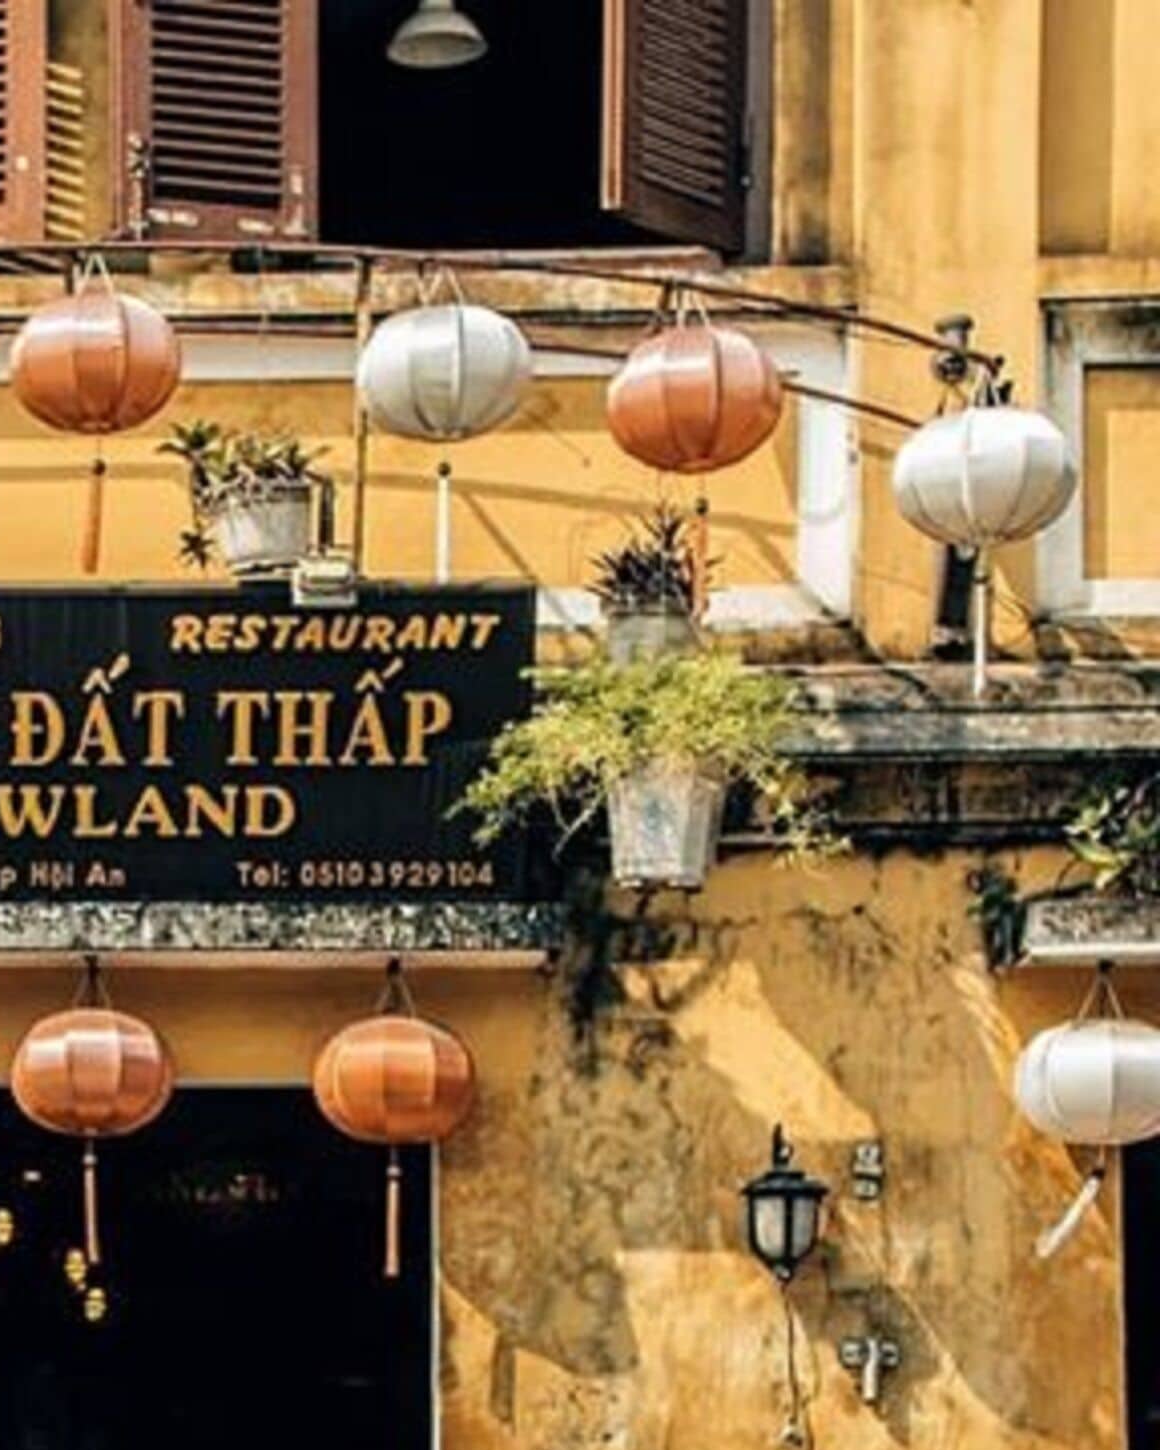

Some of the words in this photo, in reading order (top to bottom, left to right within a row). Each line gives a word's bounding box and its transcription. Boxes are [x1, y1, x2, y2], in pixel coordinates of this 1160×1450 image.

[170, 613, 501, 653] RESTAURANT
[10, 652, 185, 766] ĐẤT
[216, 656, 452, 766] THẤP
[86, 862, 126, 886] An
[237, 861, 287, 886] Tel:
